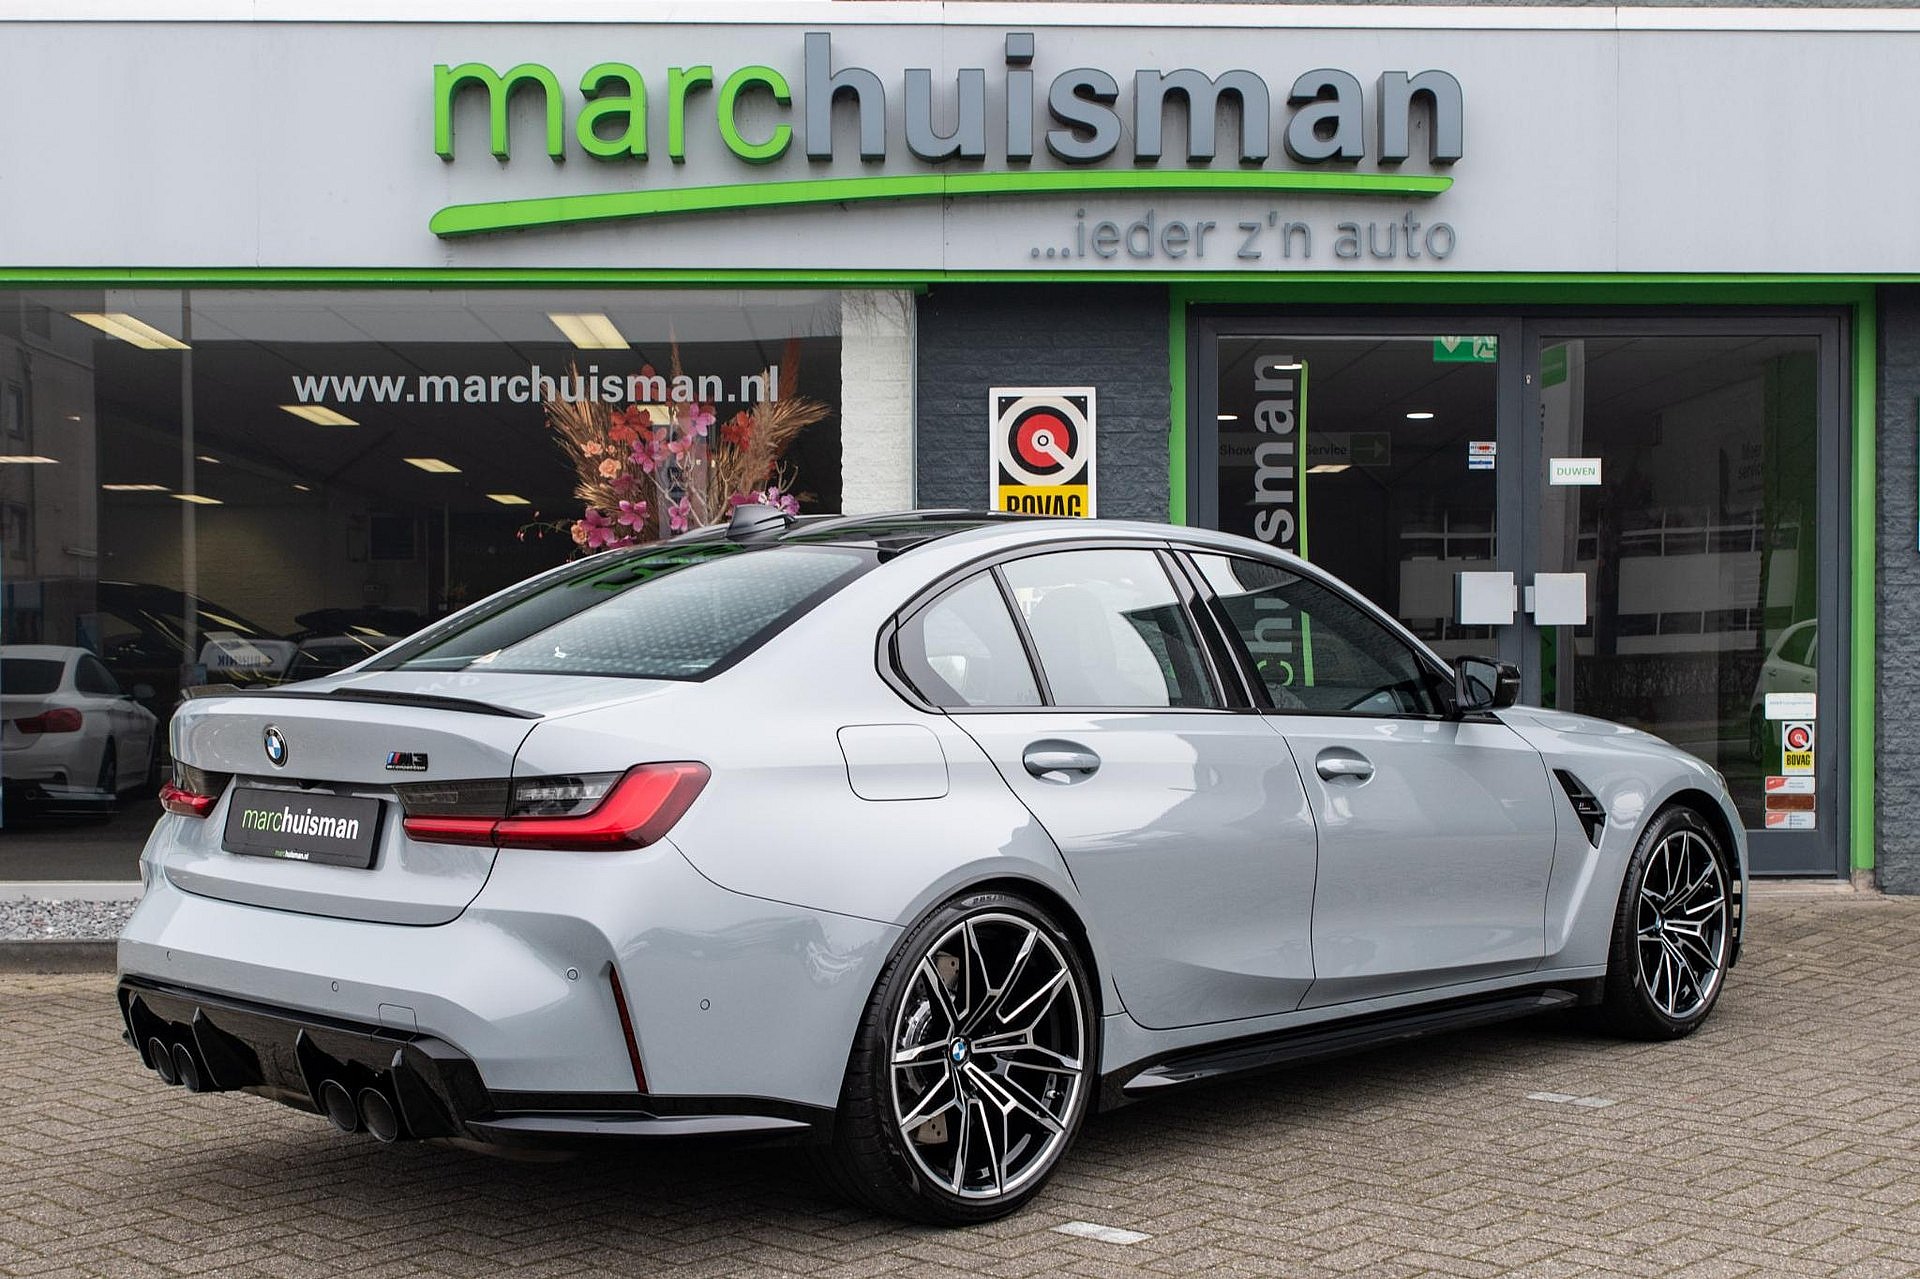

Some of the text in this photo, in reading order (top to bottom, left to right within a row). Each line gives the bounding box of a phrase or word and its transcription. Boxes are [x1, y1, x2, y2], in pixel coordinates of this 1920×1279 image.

[1237, 210, 1313, 261] z'n
[1333, 210, 1457, 261] auto
[292, 365, 780, 404] www.marchuisman.nl
[1556, 466, 1596, 476] DUWEN
[1786, 754, 1811, 766] BOVAG
[241, 806, 359, 840] marchuisman
